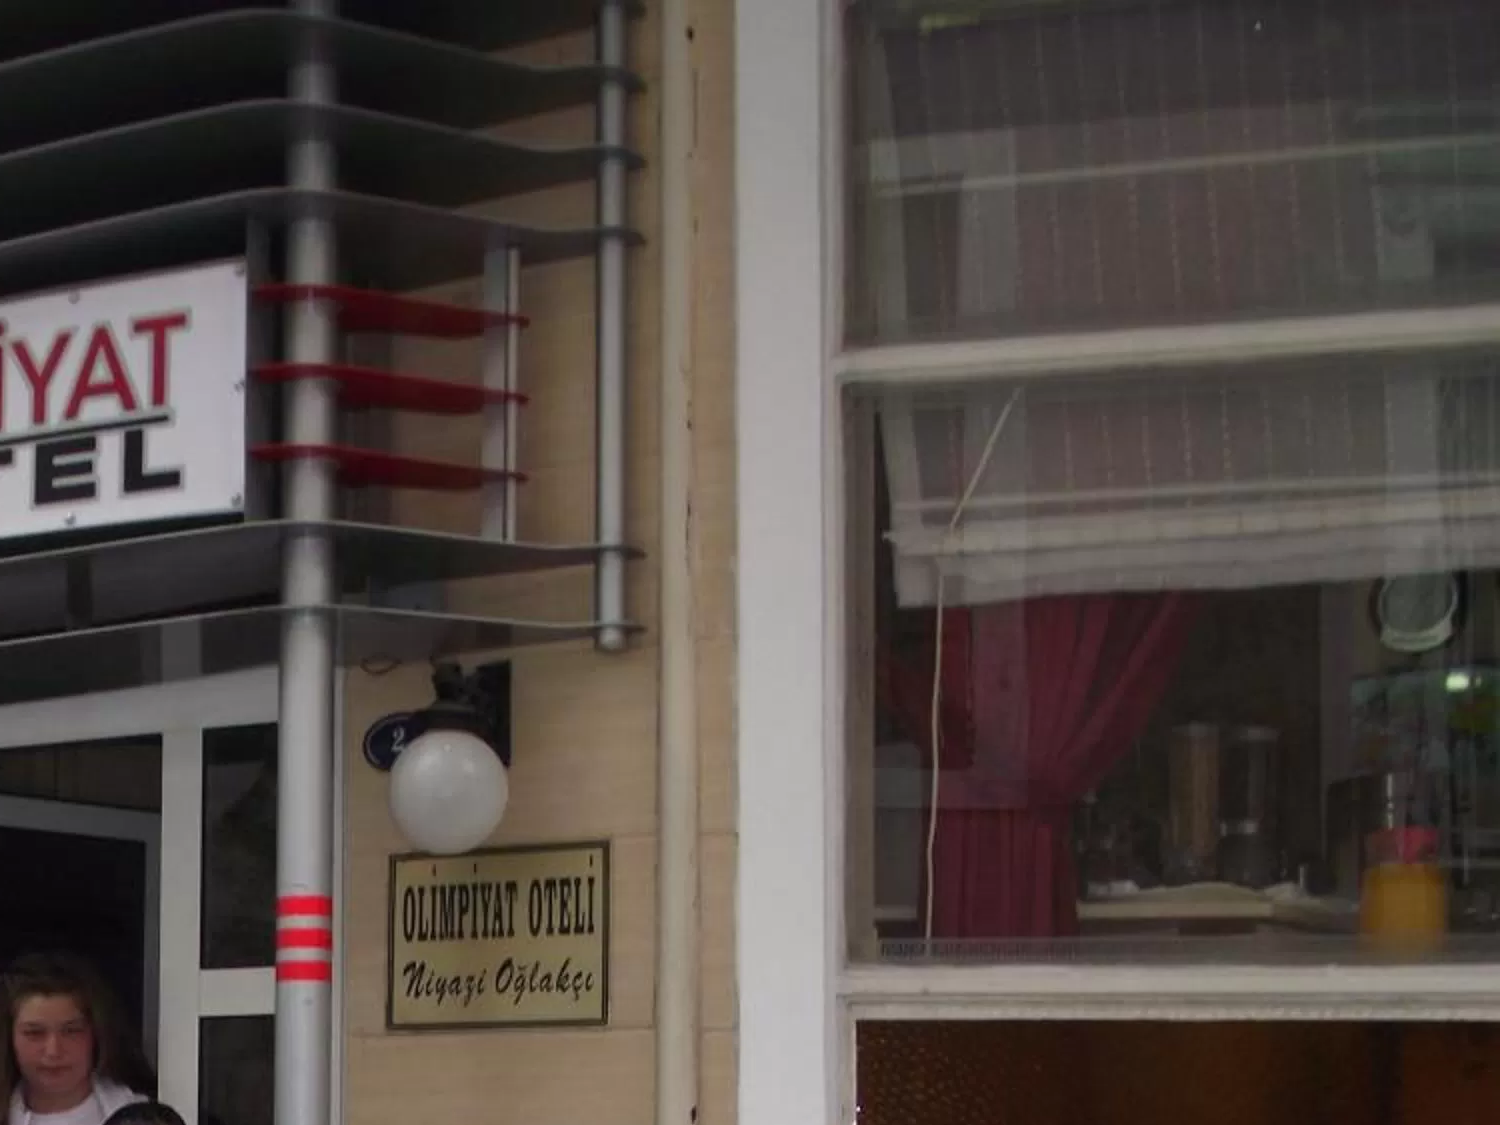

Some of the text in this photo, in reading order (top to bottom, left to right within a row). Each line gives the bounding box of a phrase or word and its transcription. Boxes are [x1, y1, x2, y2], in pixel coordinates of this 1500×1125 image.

[403, 854, 595, 942] OLİMPİYAT OTELİ
[402, 956, 595, 1007] Niyazi Oğlakçı
